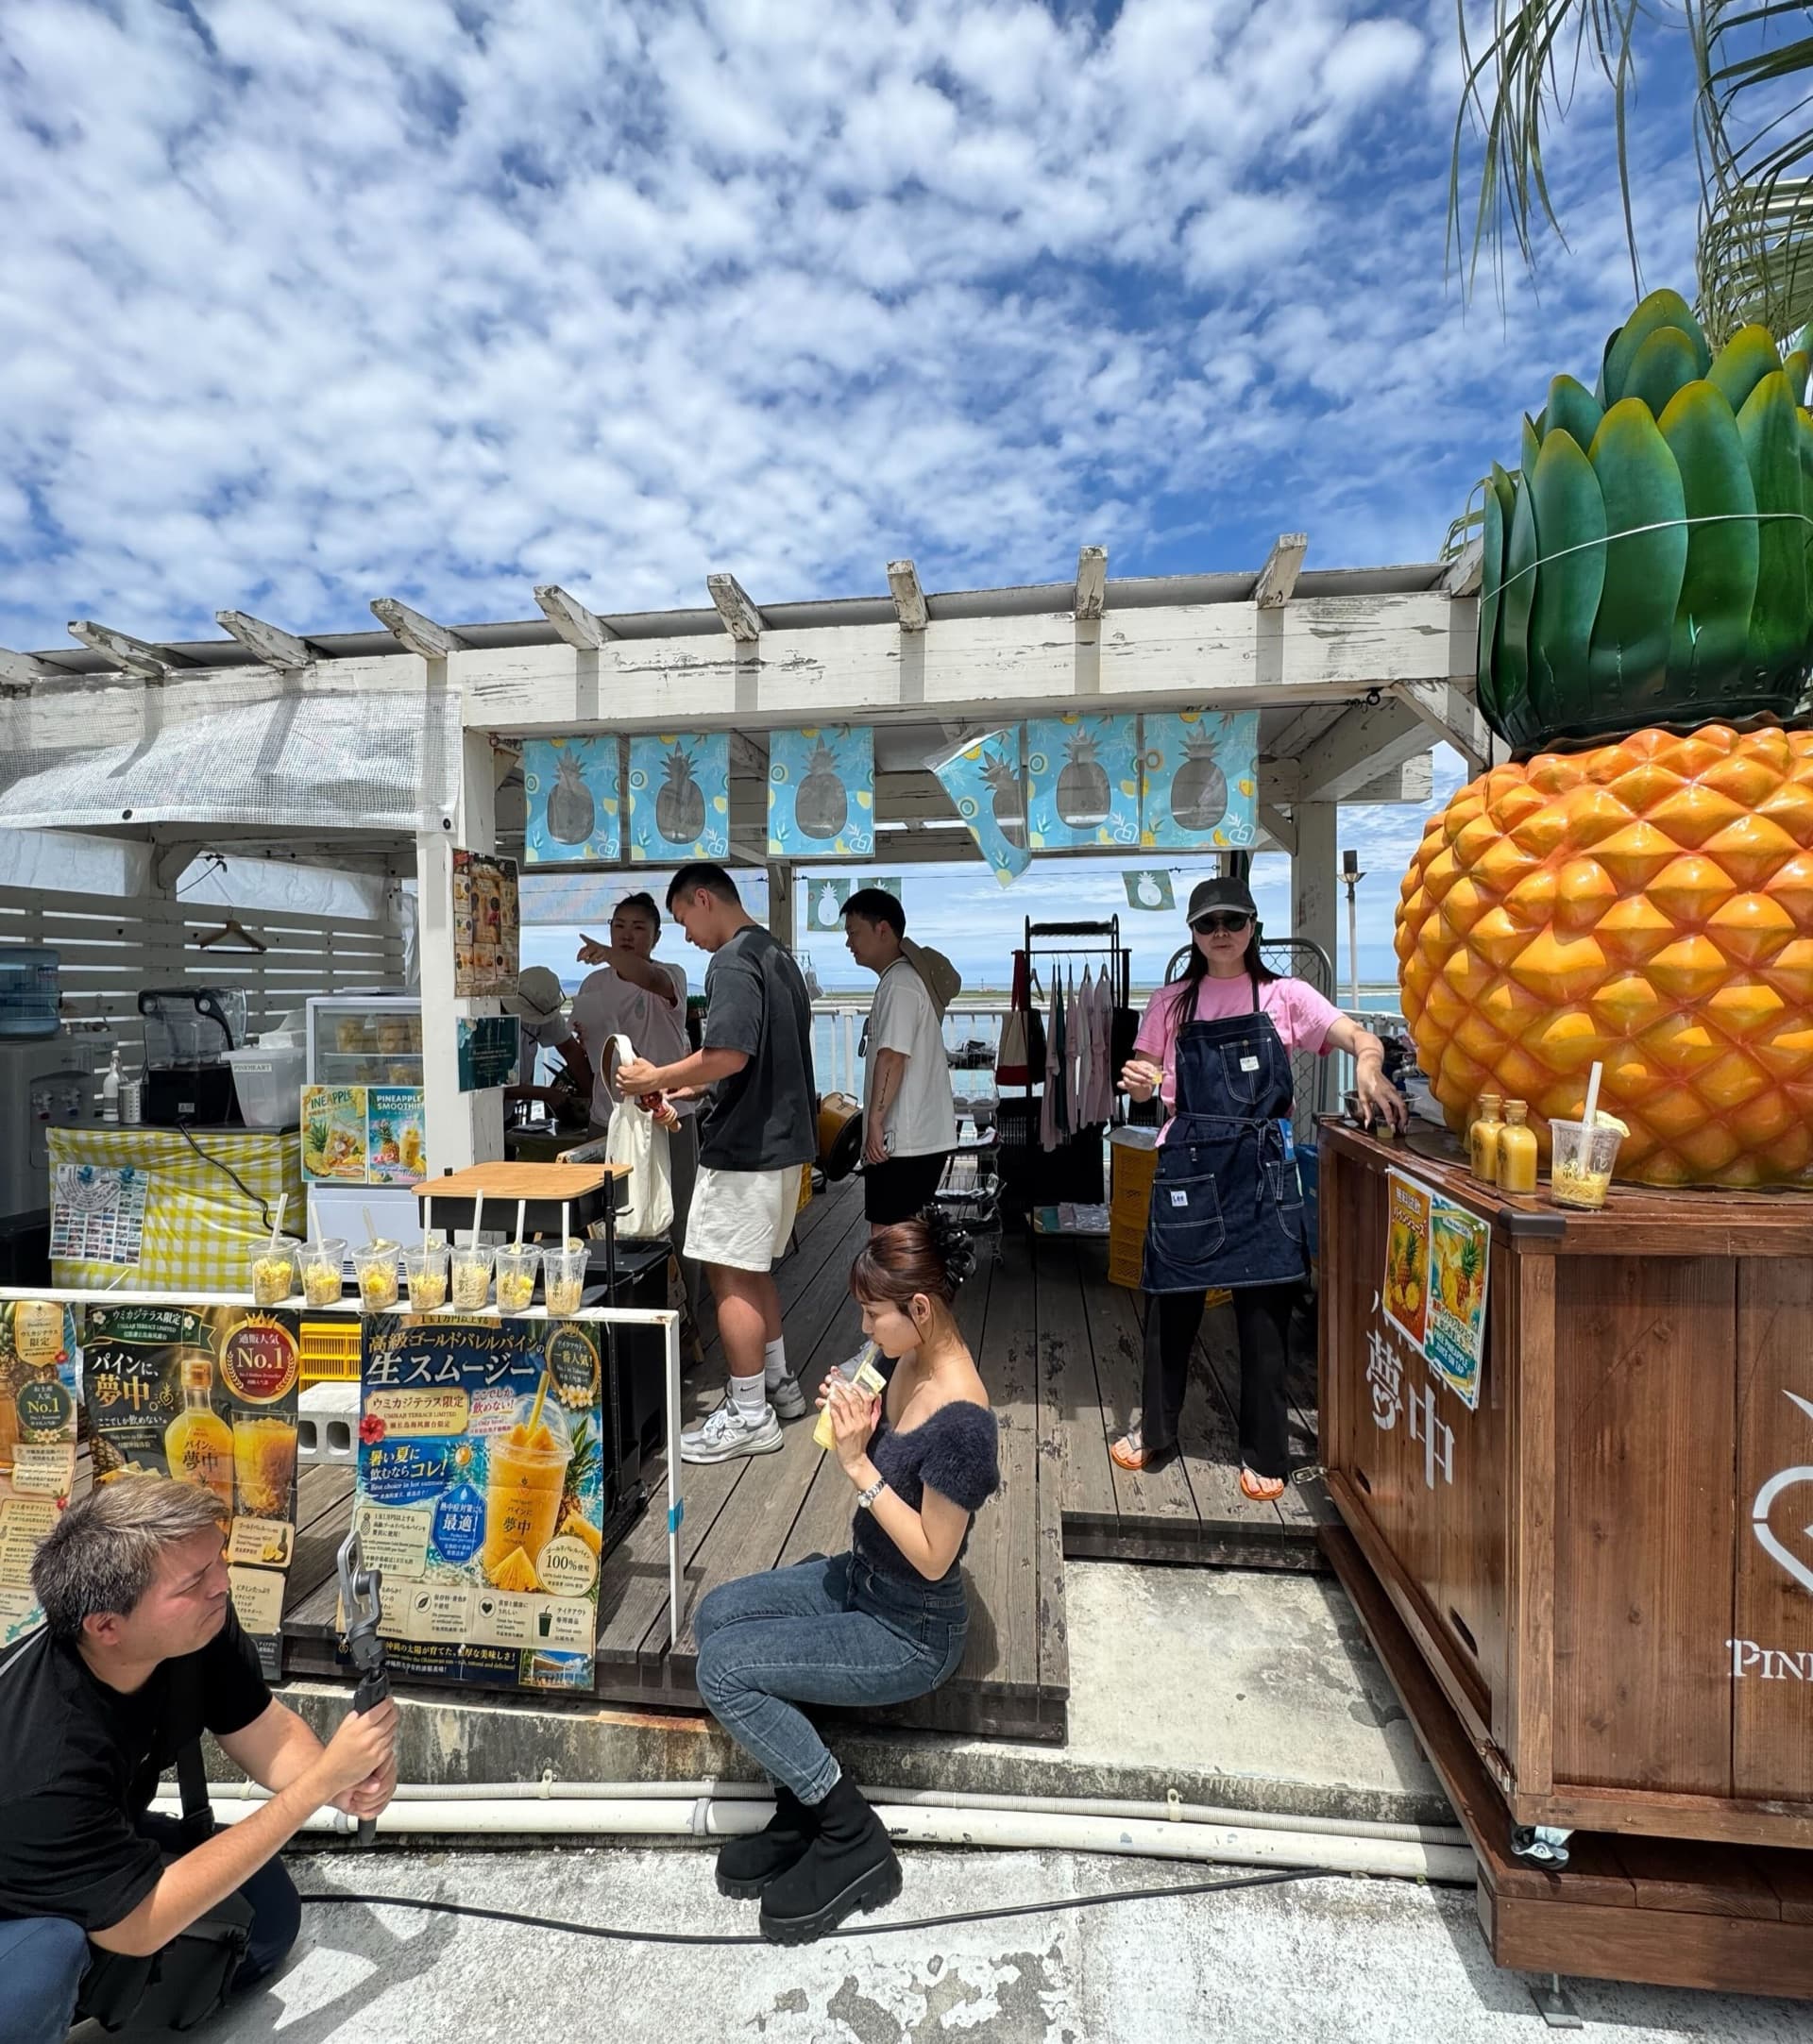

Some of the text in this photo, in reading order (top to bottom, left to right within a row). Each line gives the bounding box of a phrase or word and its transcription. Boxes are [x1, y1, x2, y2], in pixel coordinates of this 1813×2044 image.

[377, 1094, 422, 1103] PINEAPPLE
[112, 1309, 181, 1326] ウミカジテラス限定
[29, 1337, 51, 1346] 限定
[238, 1333, 280, 1345] 通販人気
[368, 1330, 545, 1354] 高級ゴールドバレルパインの
[92, 1352, 159, 1377] パインに、
[237, 1347, 284, 1369] No.1
[366, 1352, 535, 1386] 生スムージー
[94, 1374, 159, 1411] 夢中。
[26, 1397, 60, 1413] No.1
[373, 1395, 465, 1411] ウミカジテラス限定
[182, 1451, 218, 1472] 夢中
[369, 1444, 420, 1466] 暑い夏に
[370, 1459, 448, 1481] 飲むならコレ!
[503, 1516, 532, 1536] 夢中
[546, 1555, 590, 1572] 100%使用
